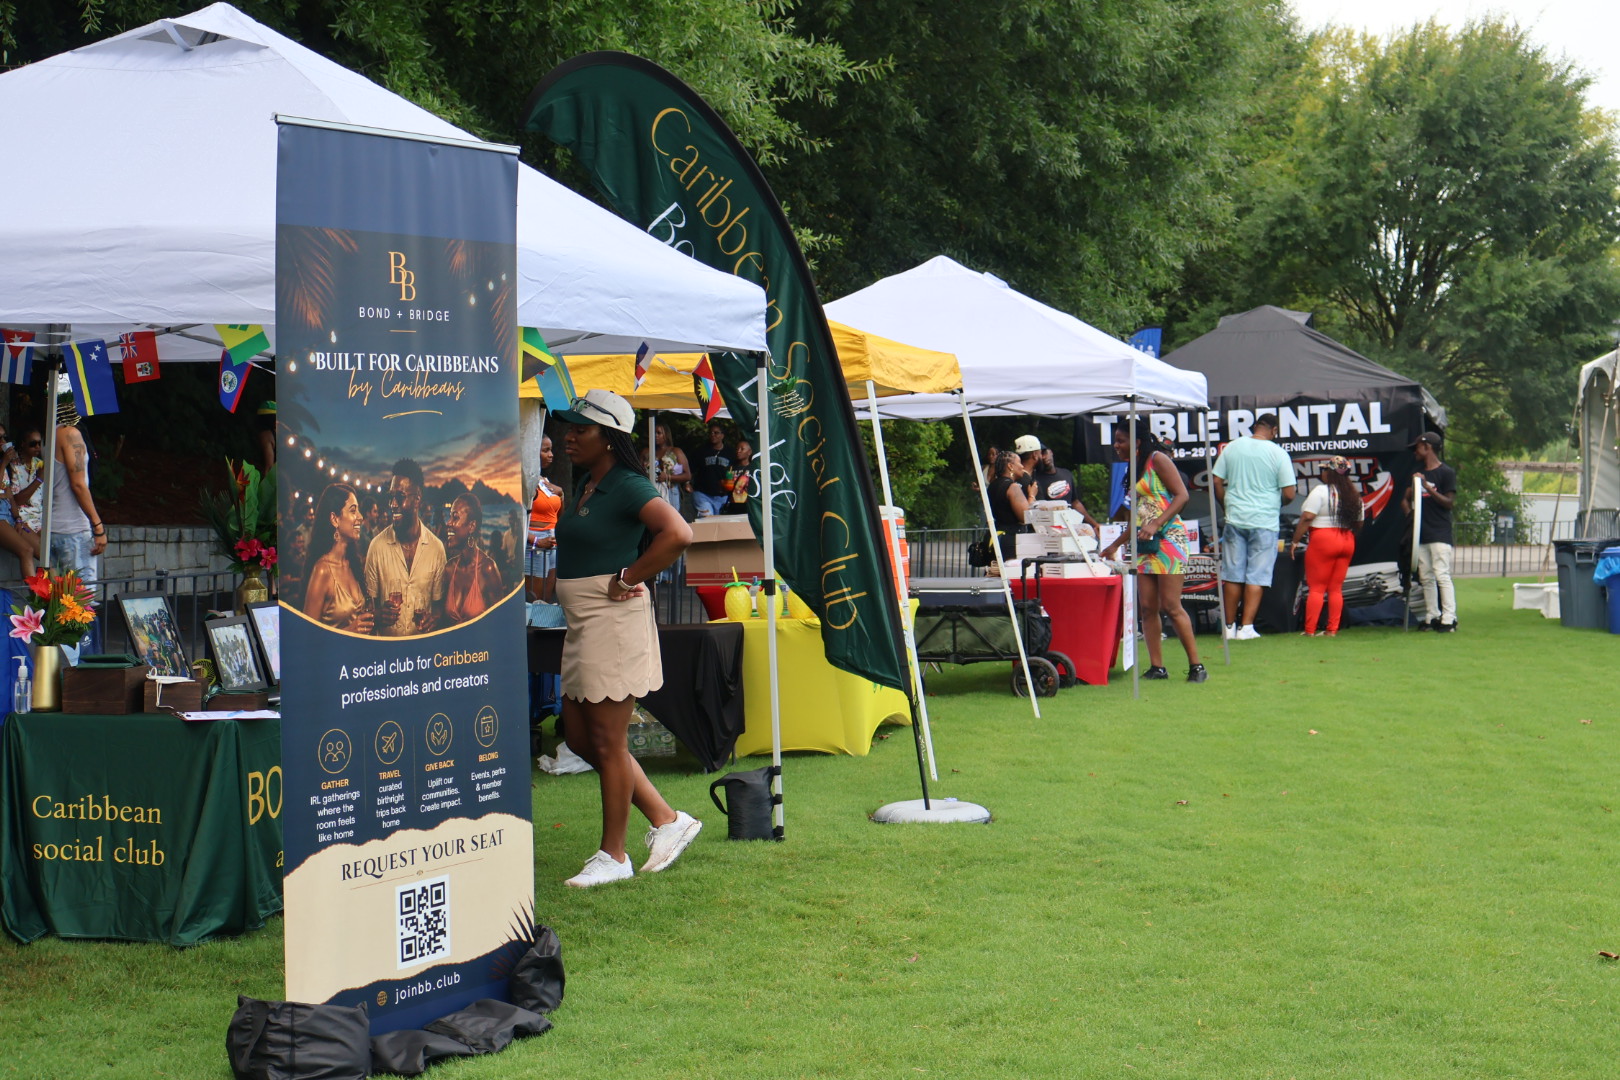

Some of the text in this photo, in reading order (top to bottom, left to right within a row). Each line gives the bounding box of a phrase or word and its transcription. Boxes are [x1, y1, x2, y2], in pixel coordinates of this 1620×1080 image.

[359, 307, 450, 322] BOND + BRIDGE
[315, 352, 499, 373] BUILT FOR CARIBBEANS
[348, 367, 373, 406] by
[1093, 411, 1220, 446] TBLE
[820, 511, 868, 631] Club
[339, 649, 489, 680] A social club for Caribbean
[341, 672, 489, 709] professionals and creators
[478, 751, 499, 763] BELONG
[425, 759, 455, 772] GIVE BACK
[379, 769, 402, 780] TRAVEL
[471, 766, 506, 781] Events, perks
[321, 778, 349, 790] GATHER
[379, 780, 403, 793] curated
[427, 776, 454, 789] Uplift our
[475, 779, 502, 791] & member
[310, 789, 360, 805] IRL gatherings
[376, 793, 405, 806] birthright
[421, 786, 460, 801] communities.
[478, 791, 500, 802] benefits.
[31, 794, 163, 824] Caribbean
[317, 804, 354, 817] where the
[375, 804, 406, 818] trips back
[420, 798, 462, 813] Create impact.
[316, 816, 355, 830] room feels
[382, 818, 400, 829] home
[318, 830, 354, 843] like home
[33, 835, 165, 866] social club
[341, 827, 505, 882] REQUEST YOUR SEAT
[394, 971, 461, 1005] joinbb.club
